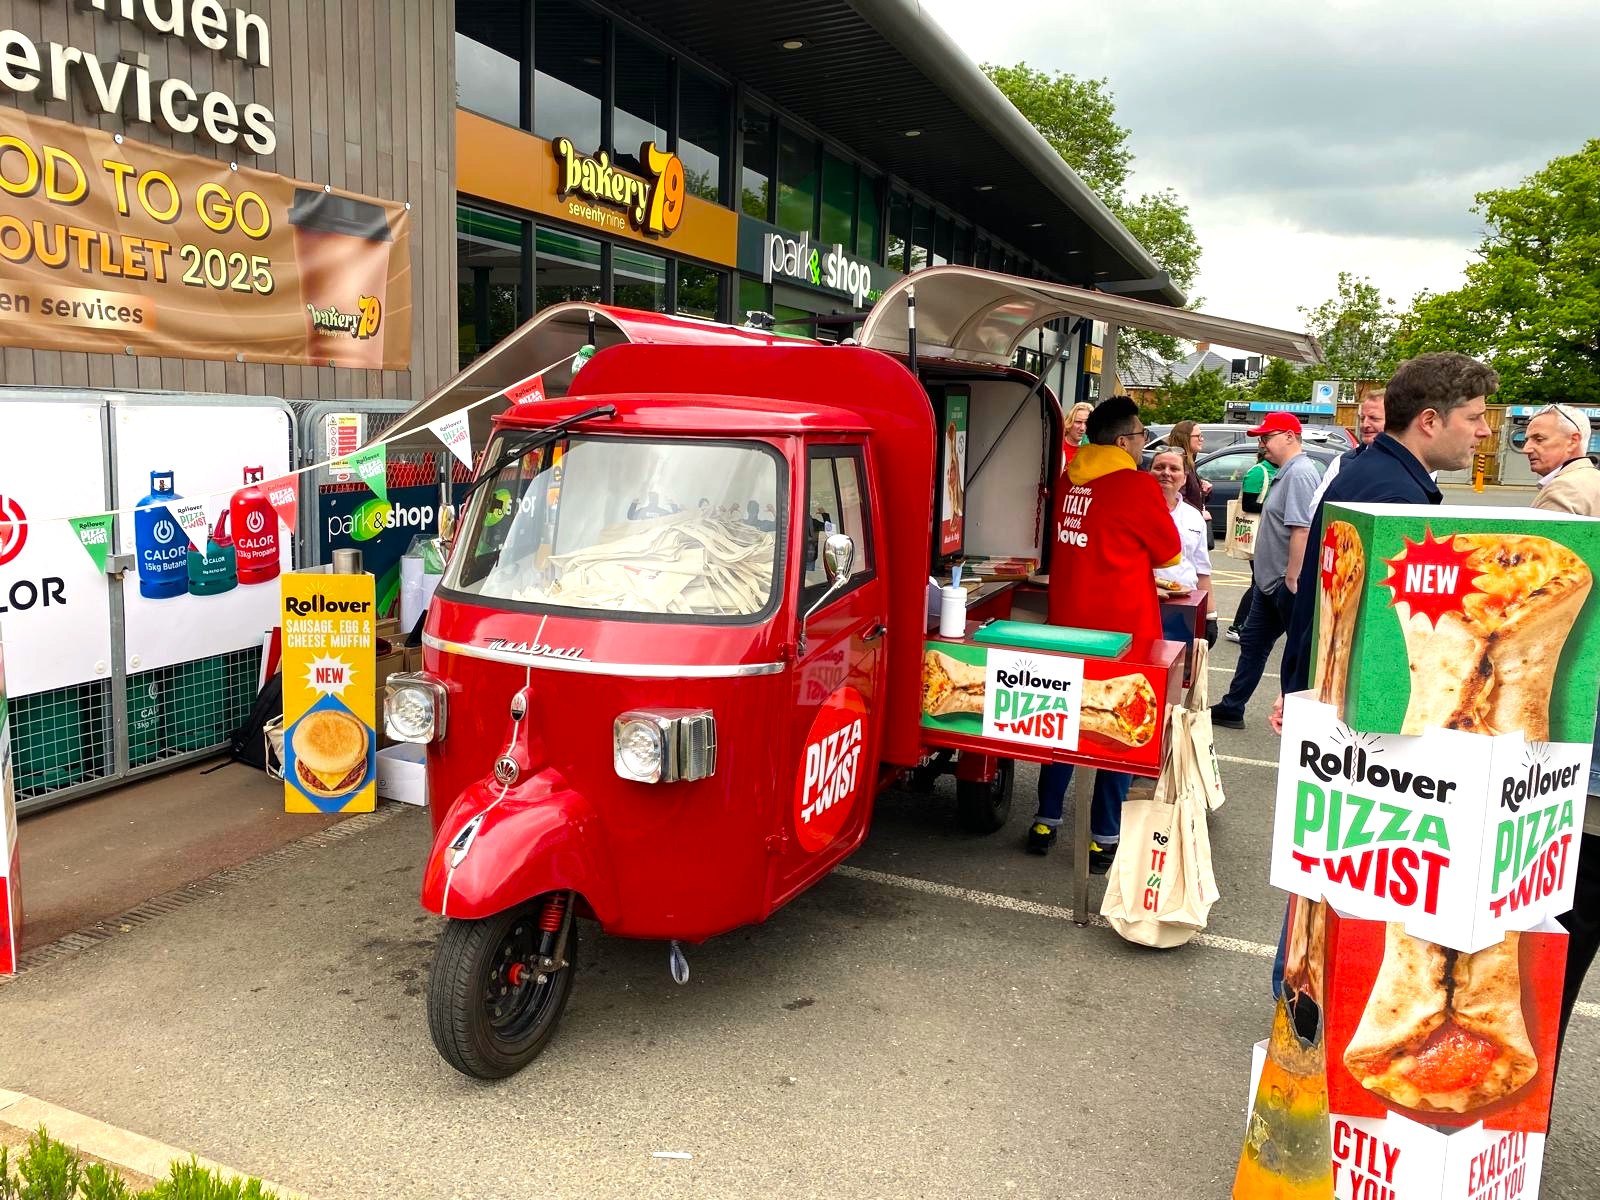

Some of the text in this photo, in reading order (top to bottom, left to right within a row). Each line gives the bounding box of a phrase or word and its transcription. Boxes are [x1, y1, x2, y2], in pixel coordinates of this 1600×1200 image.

[556, 137, 685, 233] bakery 79
[103, 159, 182, 224] TO
[196, 182, 271, 240] GO
[0, 215, 274, 295] OUTLET 2025
[40, 298, 143, 324] services
[307, 295, 381, 339] bakery 79
[443, 425, 464, 443] PIZZA
[178, 505, 203, 514] Rollover
[1062, 494, 1093, 516] ITALY
[79, 521, 105, 529] Rollover
[180, 511, 205, 526] PIZZA
[183, 516, 207, 530] TWIST
[1063, 515, 1082, 530] With
[144, 546, 186, 560] CALOR
[239, 535, 274, 549] CALOR
[252, 547, 277, 558] Propane
[145, 559, 187, 572] 15kg Butane
[209, 556, 225, 564] CALOR
[1405, 564, 1459, 595] NEW
[286, 595, 370, 616] Rollover
[286, 619, 371, 635] SAUSAGE, EGG &
[287, 634, 370, 649] CHEESE MUFFIN
[316, 668, 344, 684] NEW
[997, 669, 1071, 692] Rollover
[994, 689, 1069, 720] PIZZA
[993, 713, 1069, 740] TWIST
[802, 718, 862, 806] PIZZA
[1300, 740, 1457, 804] Rollover
[801, 745, 861, 824] TWIST
[1501, 762, 1581, 813] Rollover
[1293, 780, 1451, 852] PIZZA
[1491, 800, 1574, 894] PIZZA
[1292, 846, 1450, 916] TWIST
[1489, 833, 1572, 918] TWIST
[1468, 1132, 1528, 1197] EXACTLY
